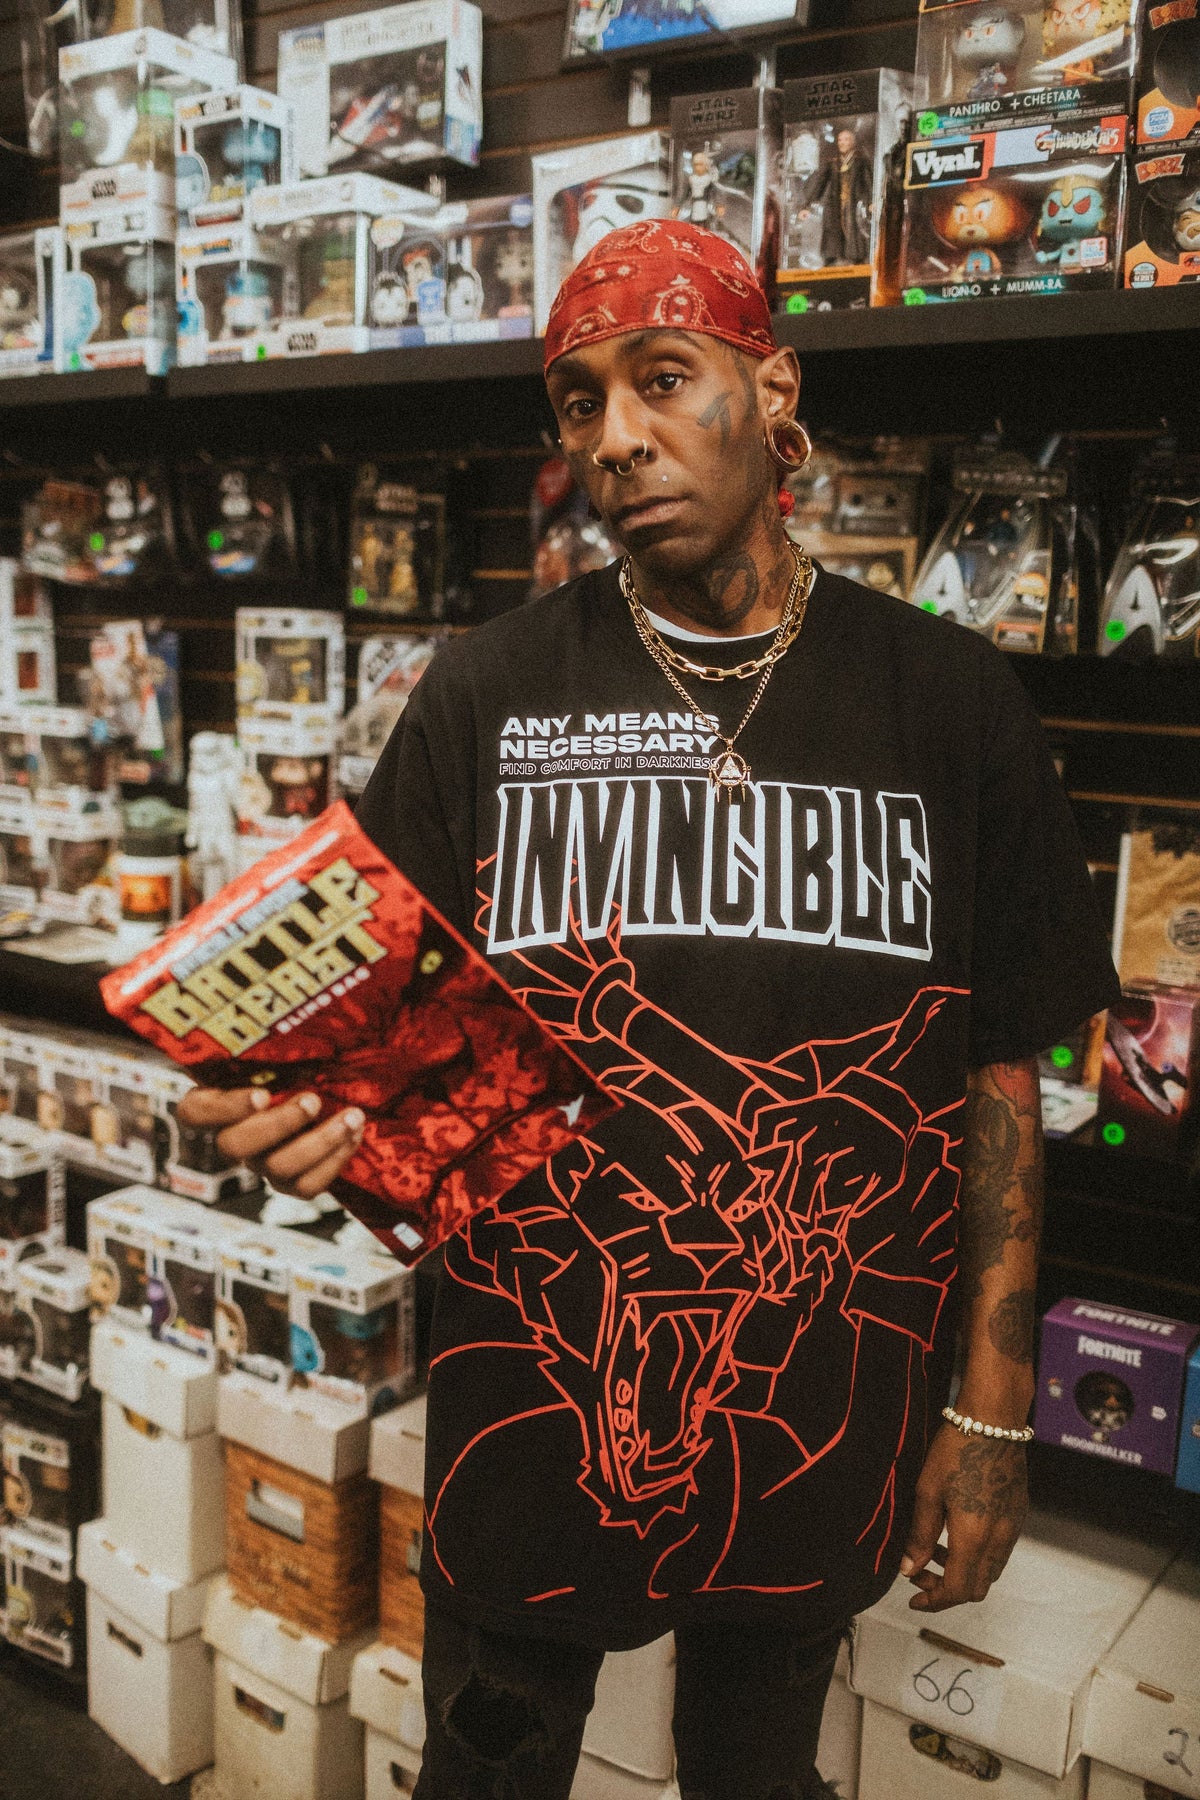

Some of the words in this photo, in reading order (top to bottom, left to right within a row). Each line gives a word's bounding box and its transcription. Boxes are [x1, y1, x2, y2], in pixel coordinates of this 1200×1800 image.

[807, 78, 857, 95] STAR
[807, 92, 852, 108] WARS
[691, 109, 736, 124] WARS
[692, 96, 737, 112] STAR
[949, 100, 1001, 118] PANTHRO
[1023, 87, 1082, 107] CHEETARA
[941, 283, 981, 298] LION-O
[1006, 276, 1063, 294] MUMM-RA
[501, 714, 572, 737] ANY
[585, 712, 720, 733] MEANS
[500, 733, 719, 759] NECESSARY
[499, 762, 535, 776] FIND
[540, 758, 612, 774] COMFORT
[614, 756, 632, 769] IN
[636, 755, 720, 770] DARKNESS
[486, 775, 933, 962] INVINCIBLE
[139, 857, 382, 1038] BATTLE
[199, 909, 388, 1058] BEAST
[1072, 1304, 1177, 1337] FORTNITE
[1077, 1334, 1142, 1369] FORTNITE
[1061, 1433, 1143, 1466] MOONWALKER
[913, 1658, 975, 1716] 66
[1162, 1727, 1200, 1777] 2
